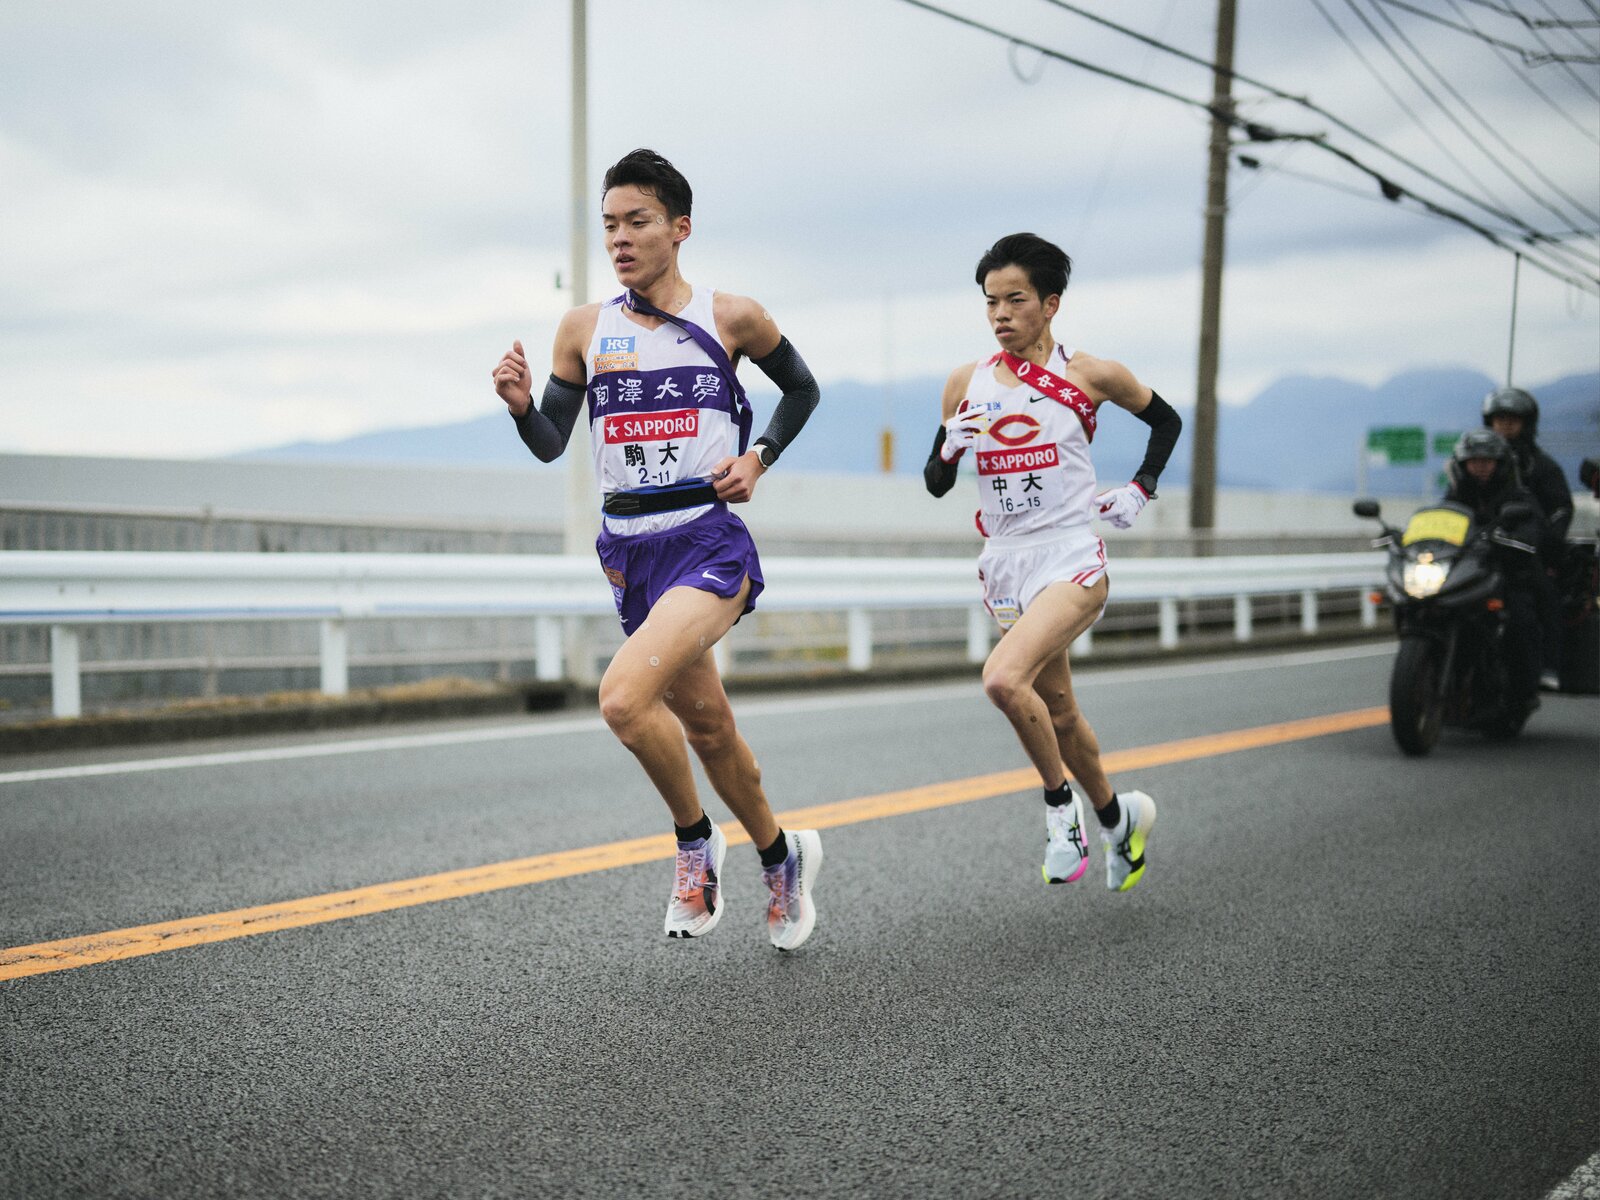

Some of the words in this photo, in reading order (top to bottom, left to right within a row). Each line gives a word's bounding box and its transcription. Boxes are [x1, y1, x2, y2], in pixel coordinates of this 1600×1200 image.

[606, 338, 630, 350] HRS
[624, 416, 696, 437] SAPPORO
[624, 442, 680, 467] 駒大
[991, 448, 1055, 470] SAPPORO
[638, 467, 670, 484] 2-11
[992, 473, 1043, 496] 中大
